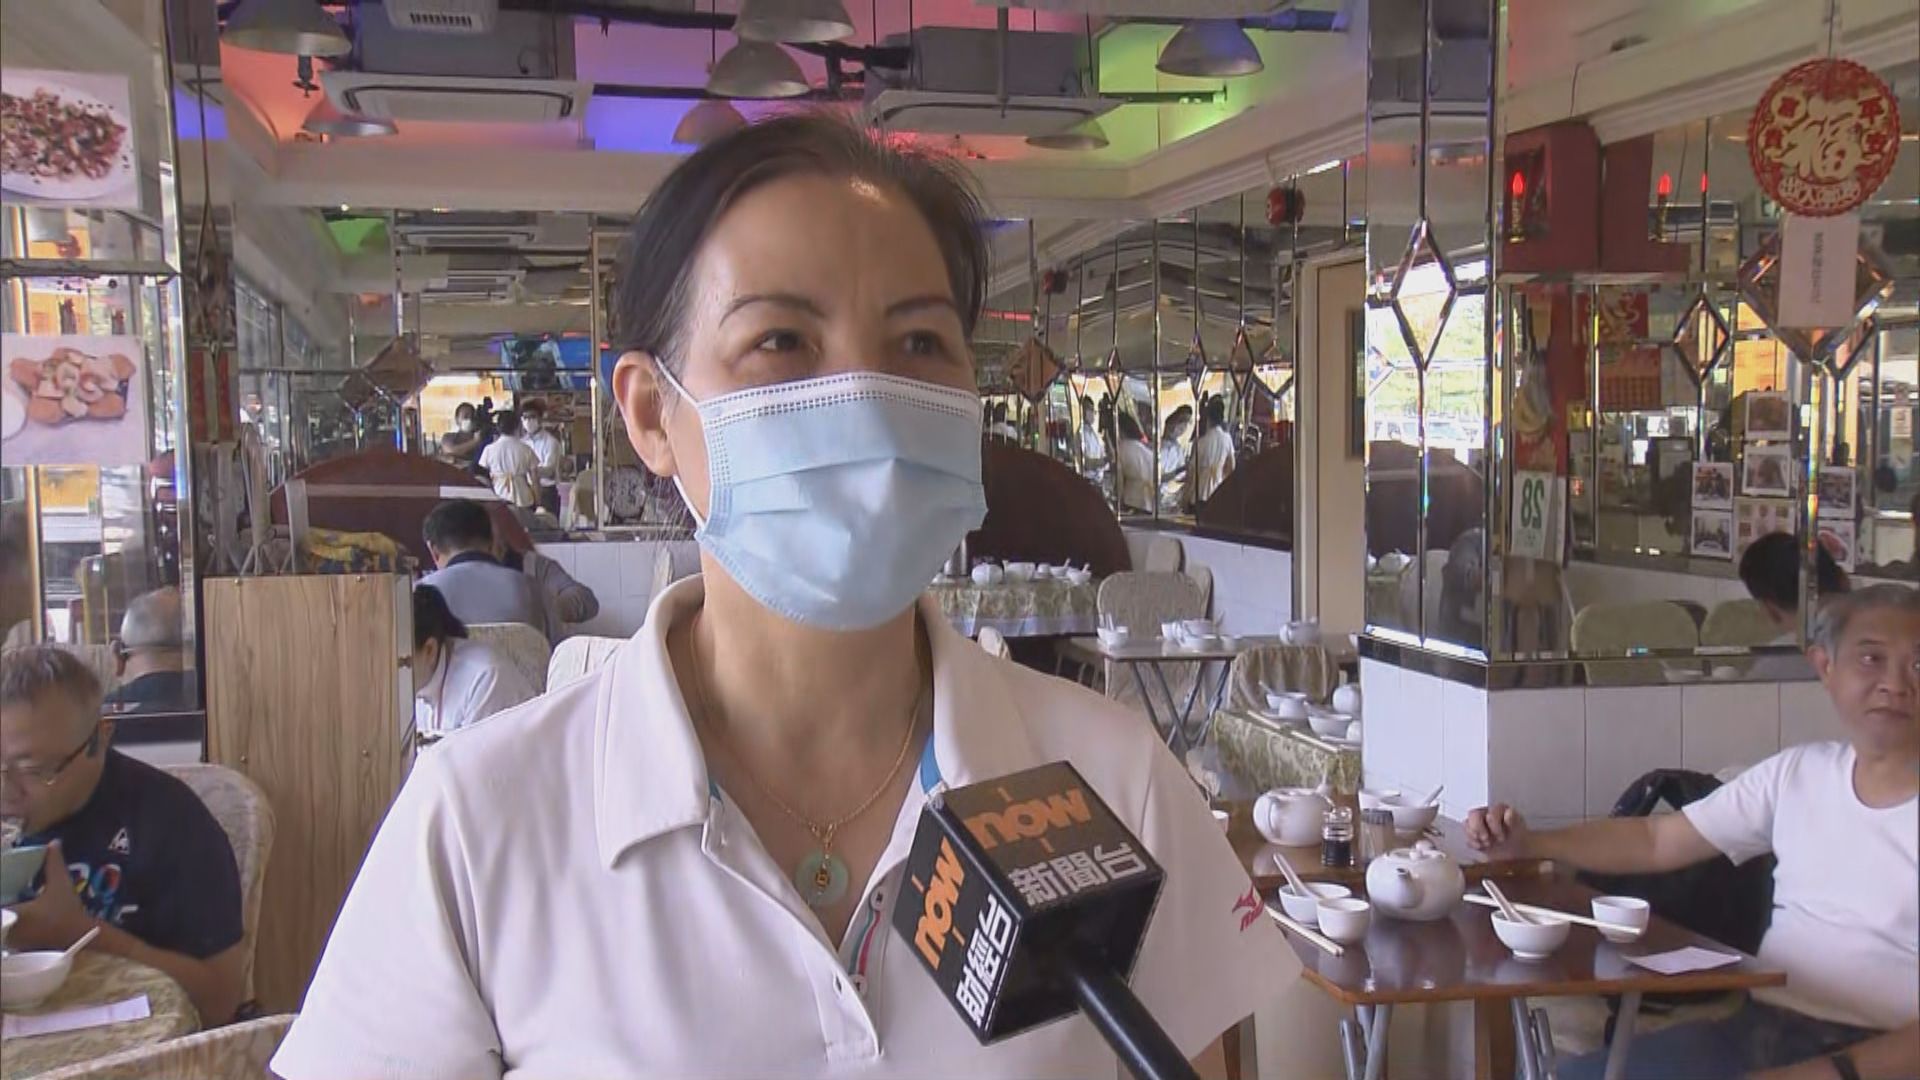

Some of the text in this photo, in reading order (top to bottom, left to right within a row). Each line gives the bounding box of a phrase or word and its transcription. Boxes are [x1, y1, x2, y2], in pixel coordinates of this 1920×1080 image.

[963, 788, 1092, 850] now
[914, 836, 965, 971] now
[1008, 842, 1147, 905] 新聞台
[956, 893, 1012, 1026] 財經台
